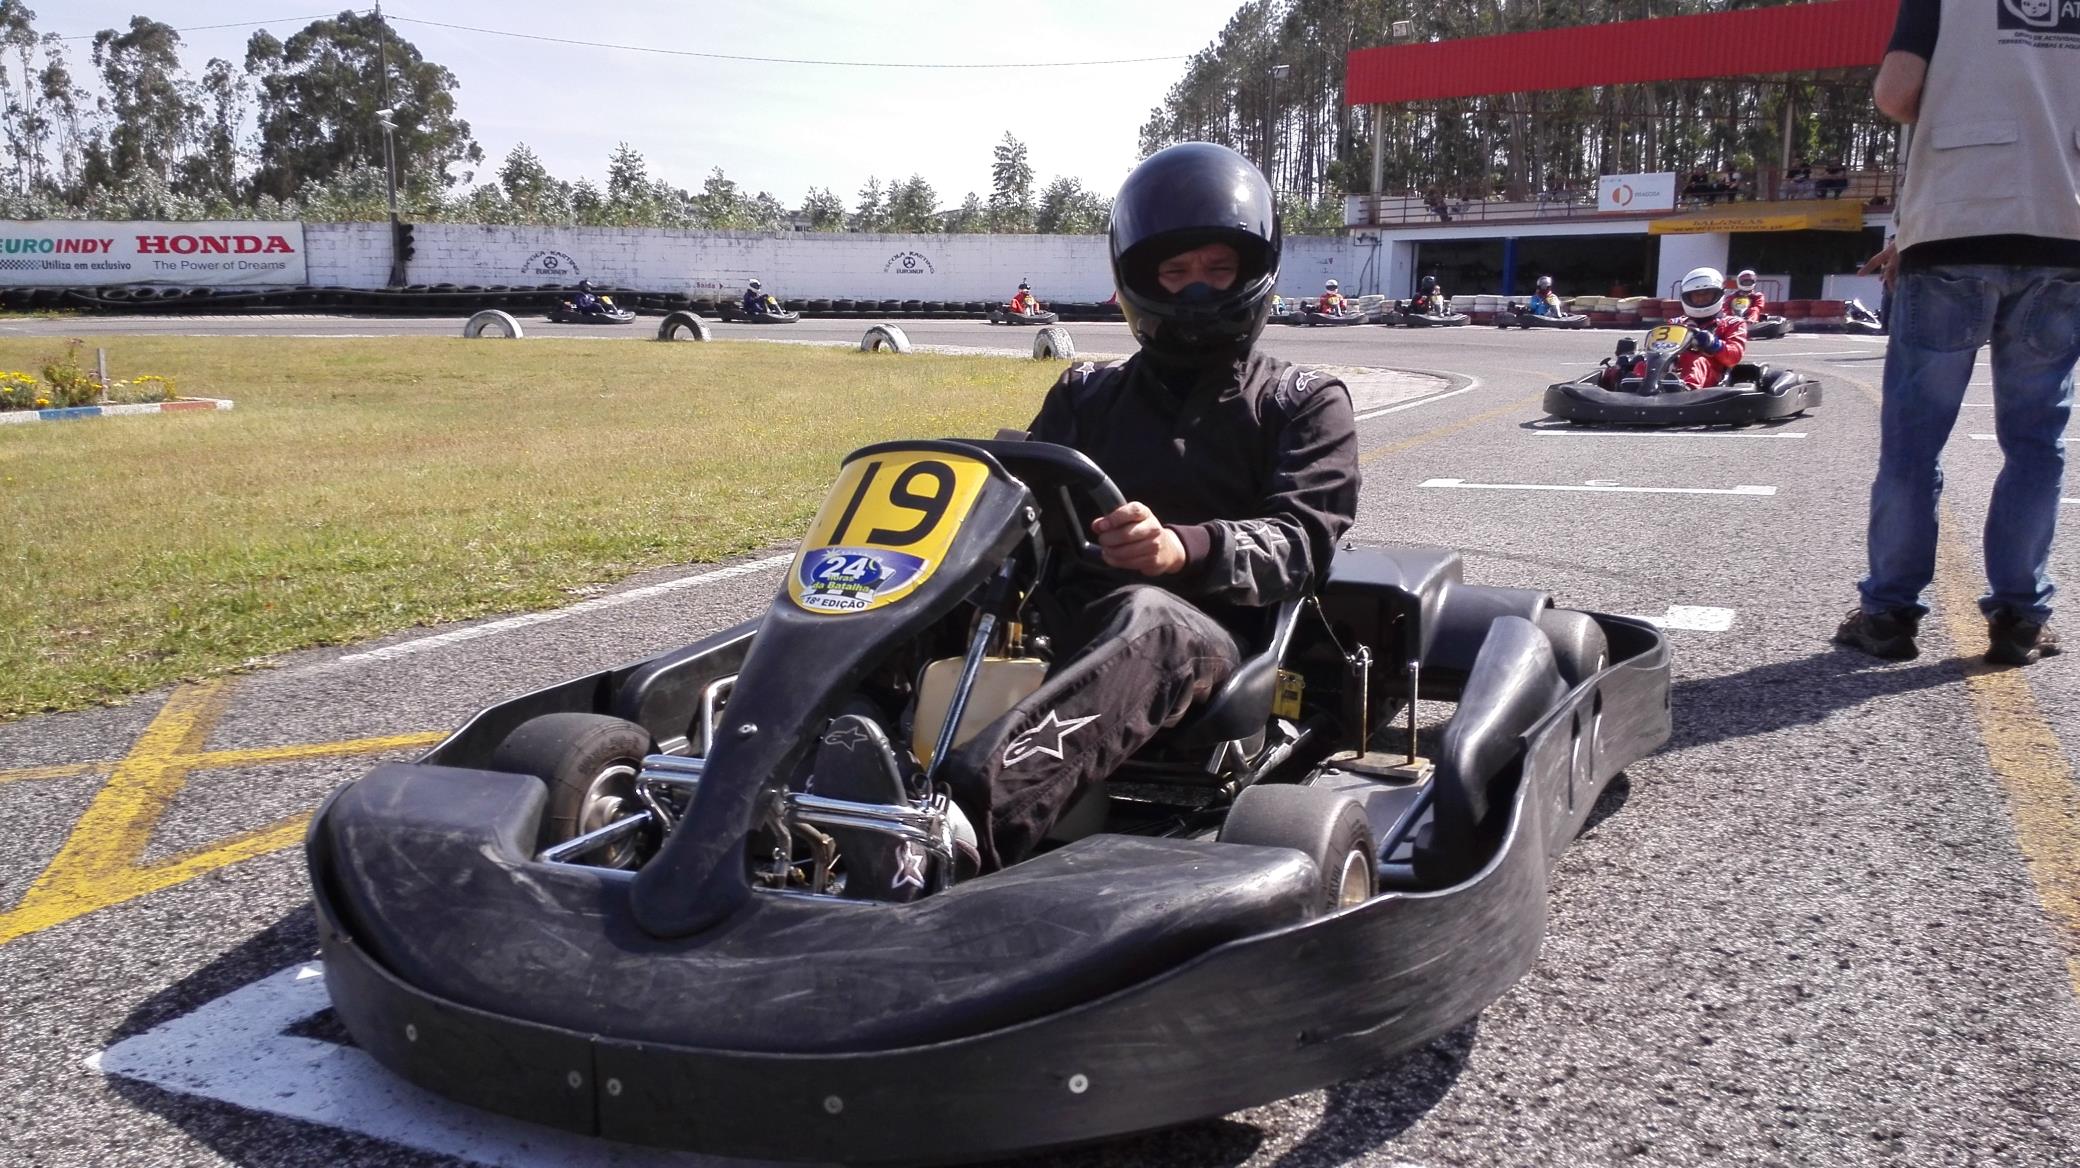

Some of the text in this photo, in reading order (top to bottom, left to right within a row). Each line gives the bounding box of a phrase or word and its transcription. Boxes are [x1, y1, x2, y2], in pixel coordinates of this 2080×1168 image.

[0, 238, 114, 254] UROINDY
[136, 235, 295, 255] HONDA
[42, 260, 71, 270] Utiliza
[91, 260, 131, 270] exclusivo
[153, 260, 286, 270] The Power of Dreams
[550, 250, 580, 275] KARTING
[909, 251, 935, 274] KARTING
[1656, 327, 1670, 341] 3
[829, 460, 956, 546] 19
[819, 556, 868, 580] 24
[827, 581, 870, 593] Batalha
